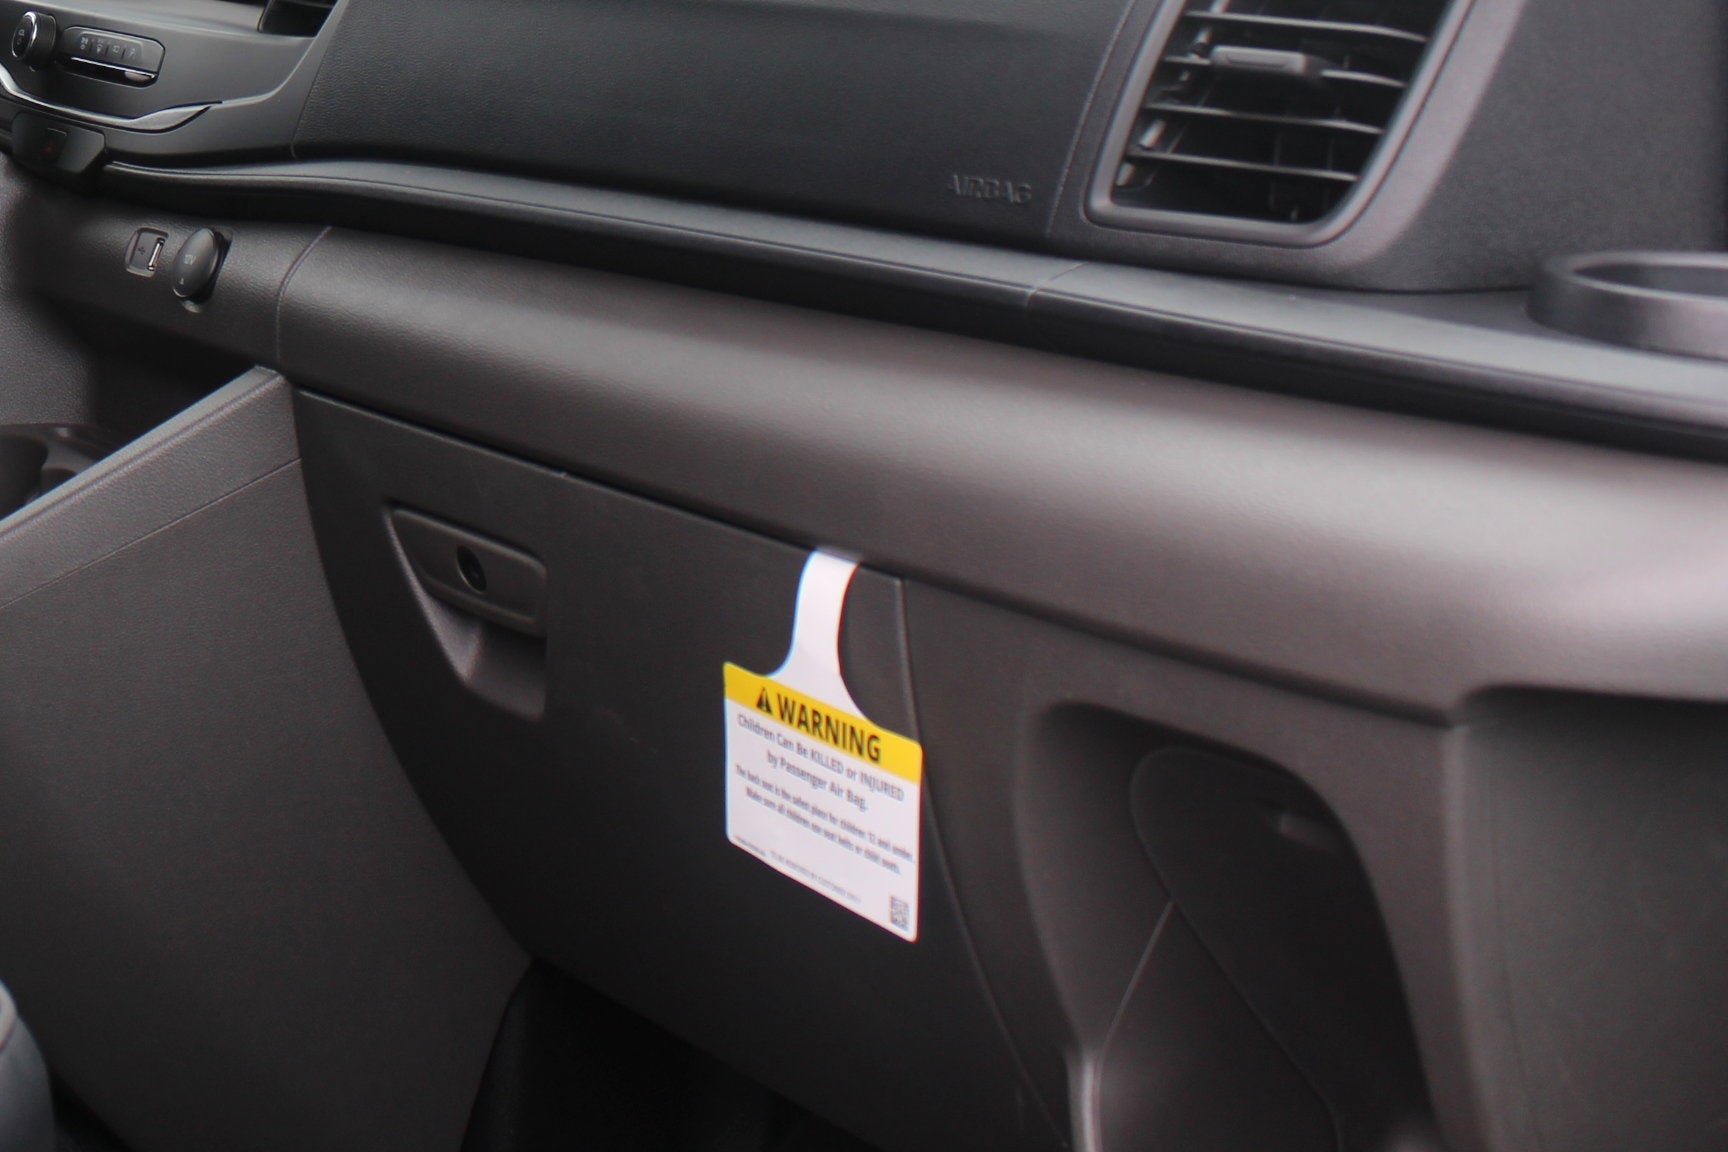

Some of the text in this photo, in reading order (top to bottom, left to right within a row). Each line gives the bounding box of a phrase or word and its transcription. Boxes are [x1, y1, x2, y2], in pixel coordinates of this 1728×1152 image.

[946, 174, 1033, 205] AIRBAG
[777, 693, 881, 763] WARNING
[737, 713, 905, 802] Children Can Be KILLED or INJURED
[767, 750, 778, 768] by
[780, 755, 828, 790] Passenger
[830, 782, 844, 797] Air
